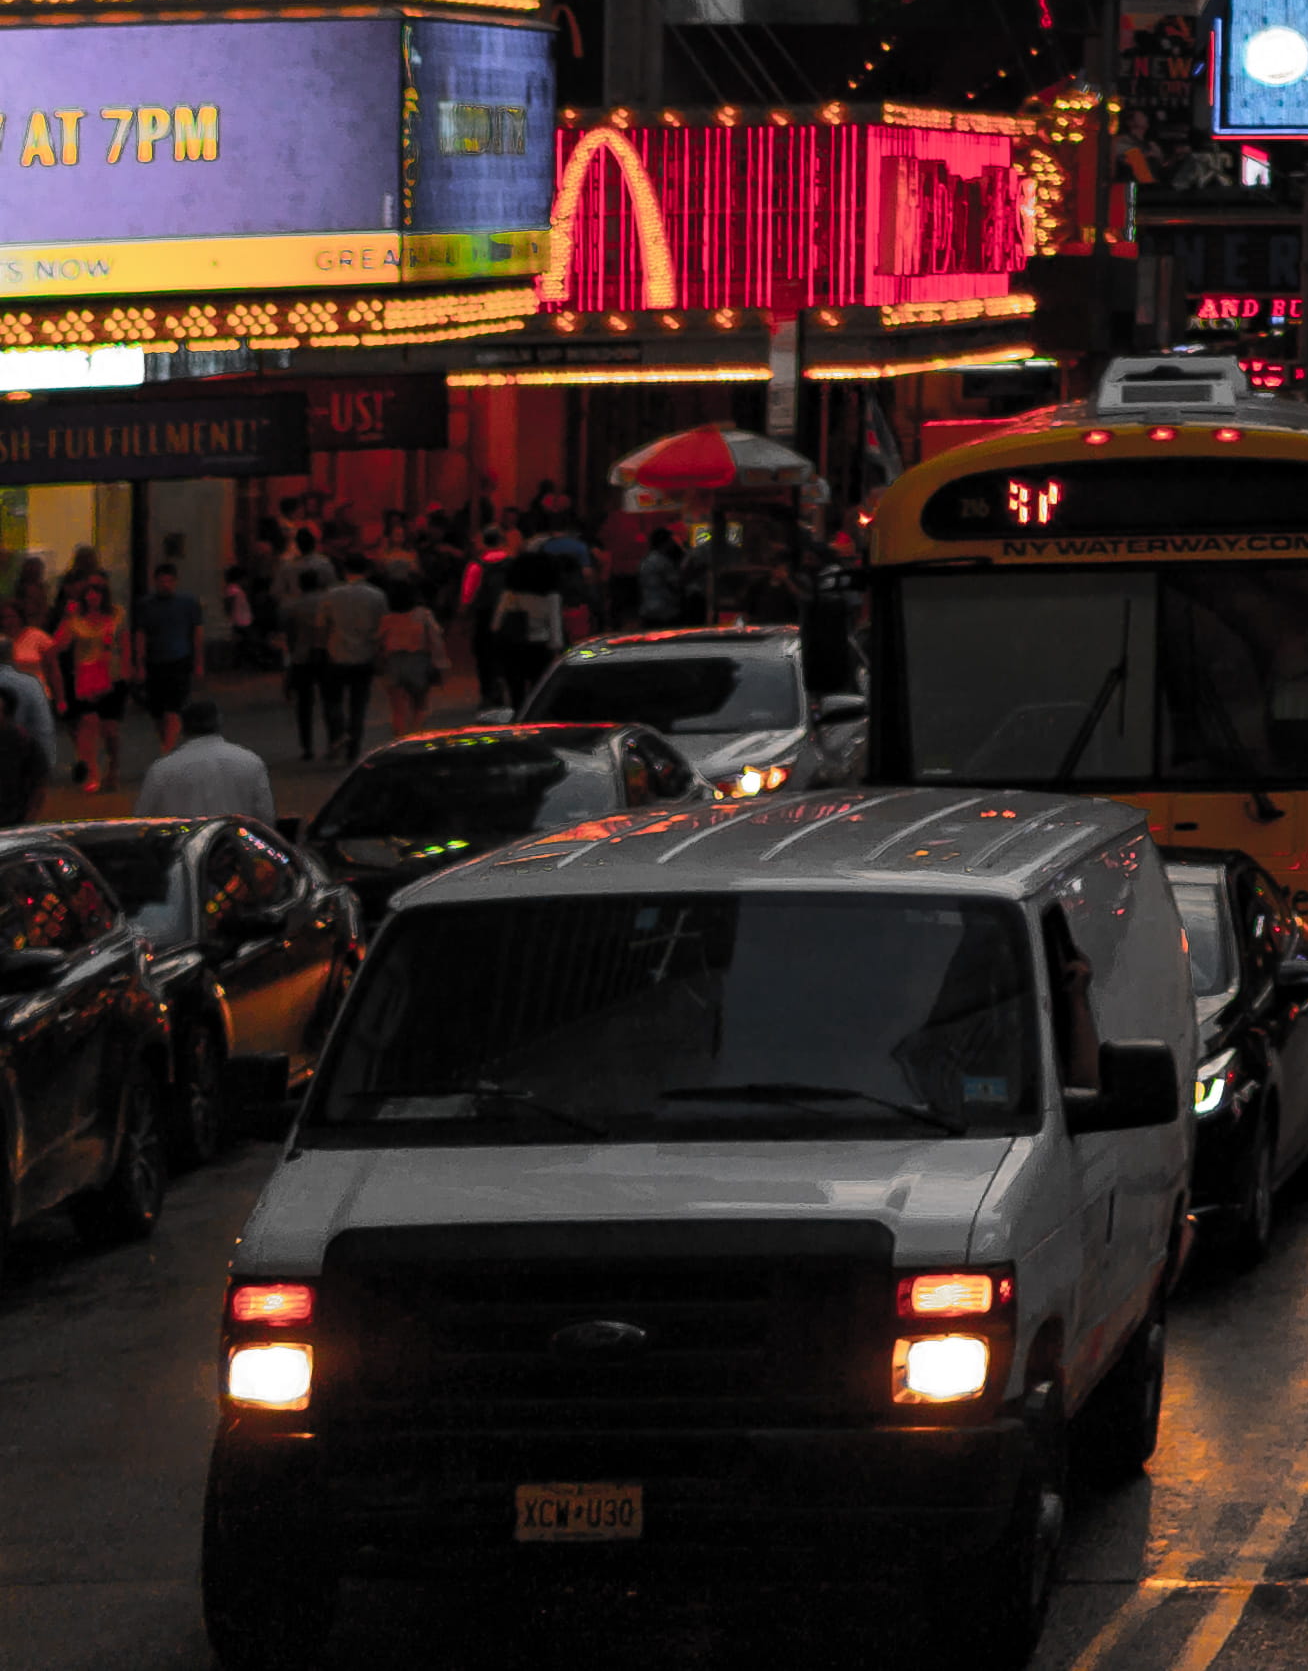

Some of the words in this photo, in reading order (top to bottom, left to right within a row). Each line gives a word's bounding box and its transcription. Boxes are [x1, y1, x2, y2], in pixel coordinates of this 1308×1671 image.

[20, 108, 85, 167] AT
[101, 103, 219, 165] 7PM
[1197, 294, 1262, 319] AND
